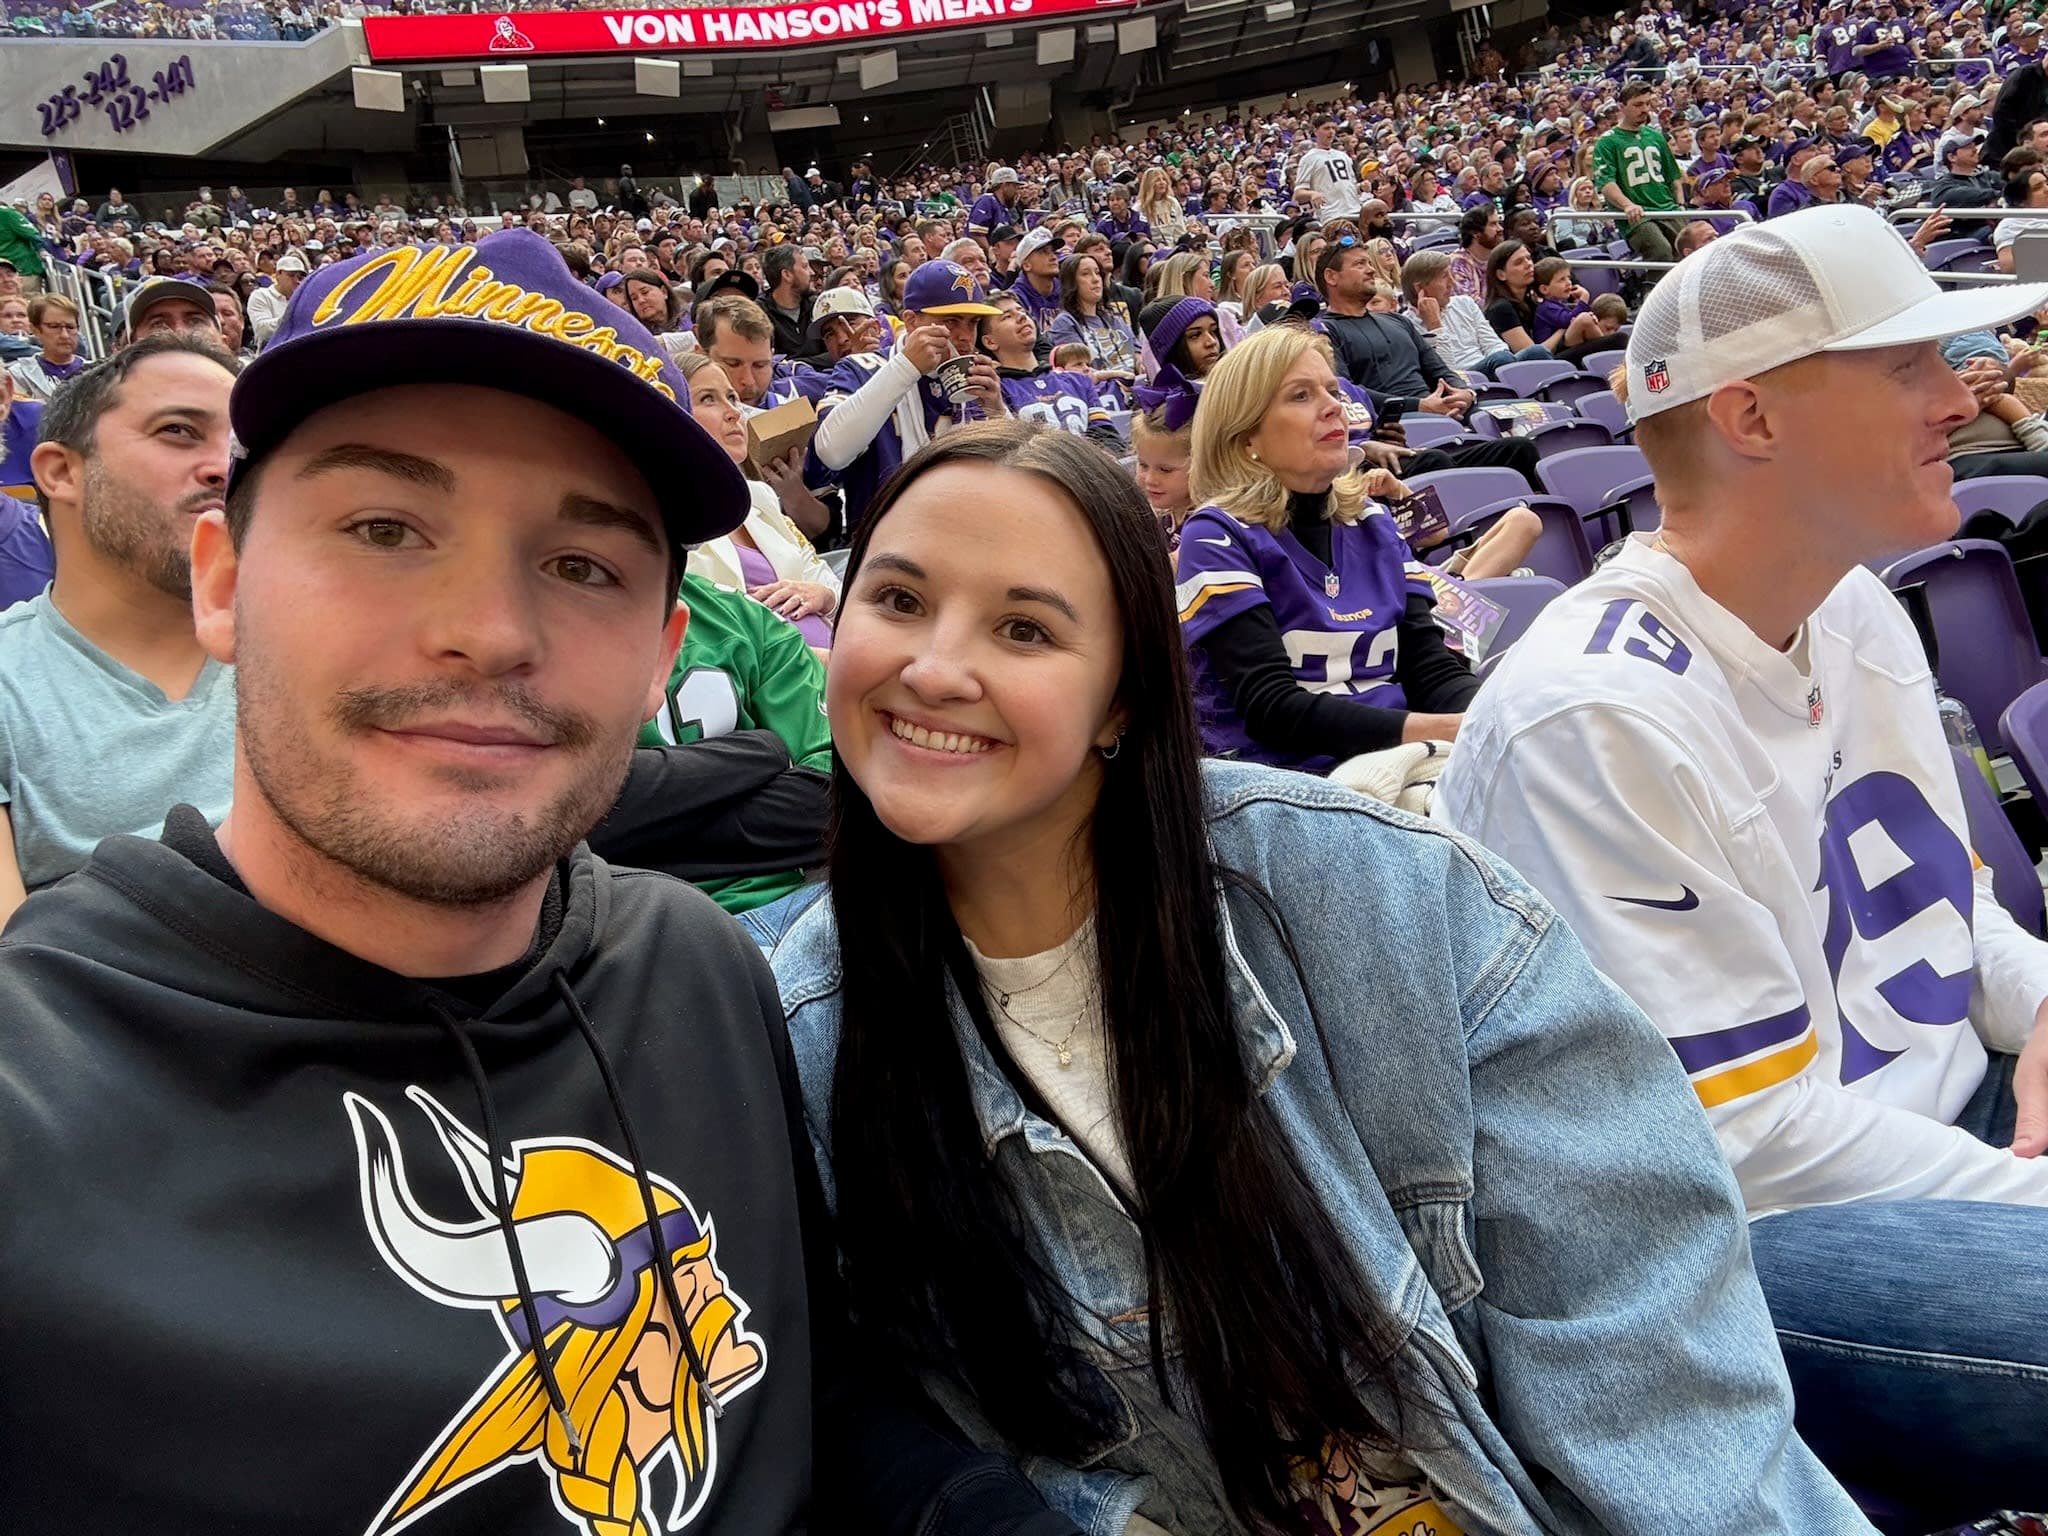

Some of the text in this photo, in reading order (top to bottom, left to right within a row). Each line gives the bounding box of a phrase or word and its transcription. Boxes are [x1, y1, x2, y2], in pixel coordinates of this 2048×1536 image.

[603, 14, 696, 44] VON
[702, 0, 903, 42] HANSON'S
[36, 53, 131, 136] 225-242
[104, 55, 195, 133] 122-141
[1324, 159, 1350, 183] 18
[1623, 145, 1665, 188] 26
[313, 245, 677, 401] Minnesot
[1647, 371, 1669, 390] NFL
[1583, 598, 1693, 676] 19
